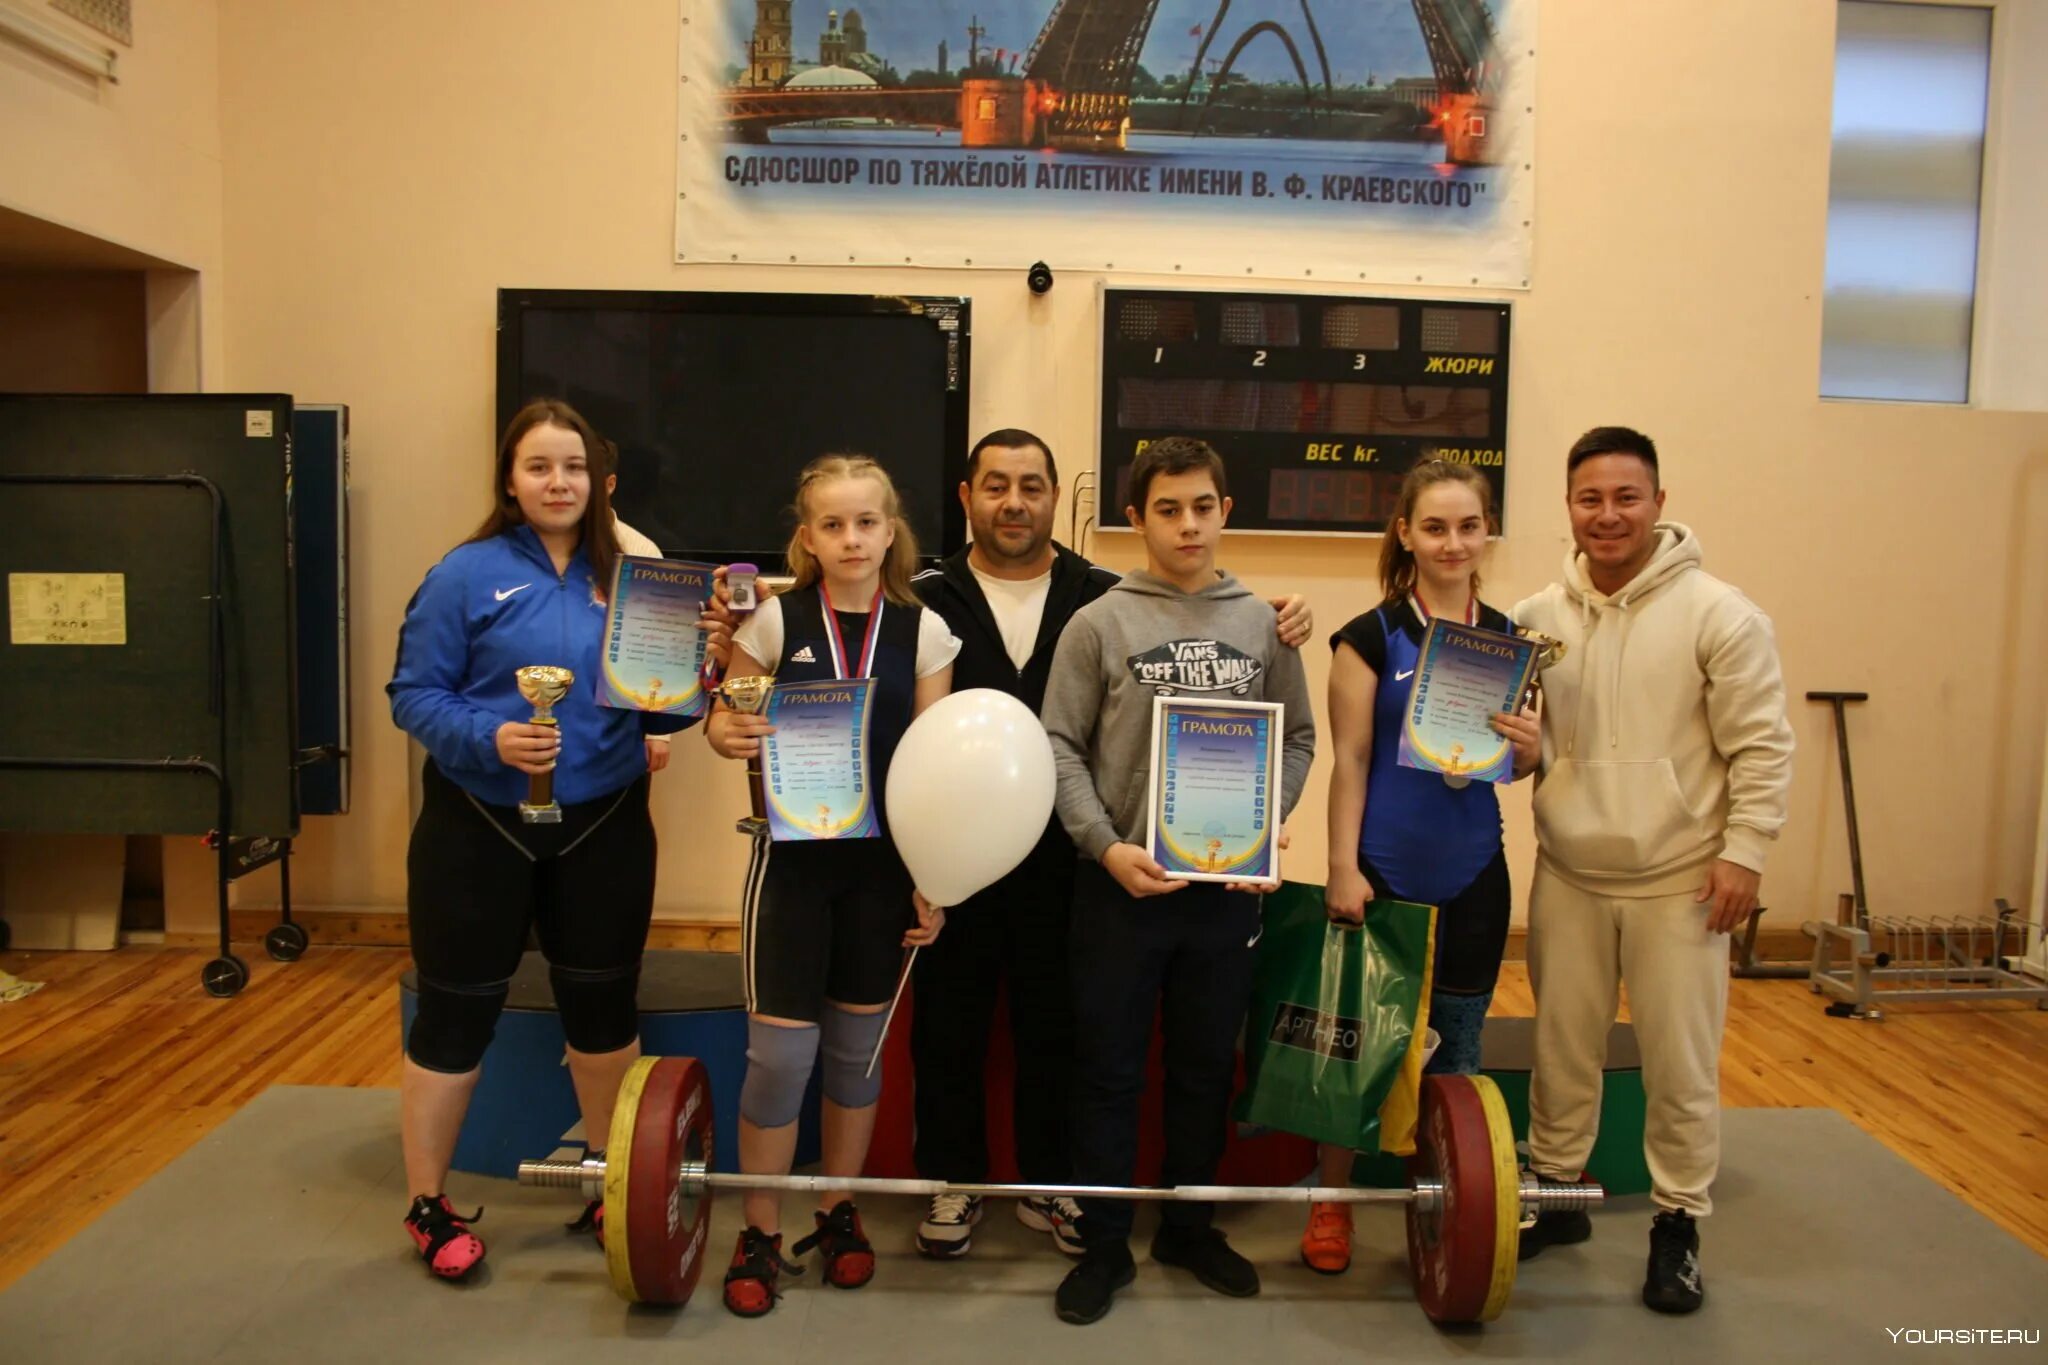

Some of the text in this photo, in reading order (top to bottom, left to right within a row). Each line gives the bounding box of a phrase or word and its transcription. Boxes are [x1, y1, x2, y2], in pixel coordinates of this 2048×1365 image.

[725, 155, 860, 186] СДЮСШОР
[869, 159, 900, 186] ПО
[911, 154, 1027, 188] ТЯЖЁЛОЙ
[1035, 162, 1151, 193] АТЛЕТИКЕ
[1160, 167, 1242, 196] ИМЕНИ
[1252, 171, 1275, 198] В.
[1284, 173, 1312, 200] Ф.
[1154, 347, 1163, 363] 1
[1252, 350, 1267, 367] 2
[1353, 353, 1366, 370] 3
[1424, 356, 1494, 375] ЖЮРИ
[1305, 443, 1344, 461] ВЕС
[1438, 448, 1503, 466] ПОДХОД
[634, 569, 703, 587] ГРАМОТА
[1168, 640, 1218, 661] VANS
[1446, 633, 1515, 661] ГРАМОТА
[1175, 660, 1212, 686] THE
[783, 691, 852, 705] ГРАМОТА
[1182, 720, 1254, 737] ГРАМОТА
